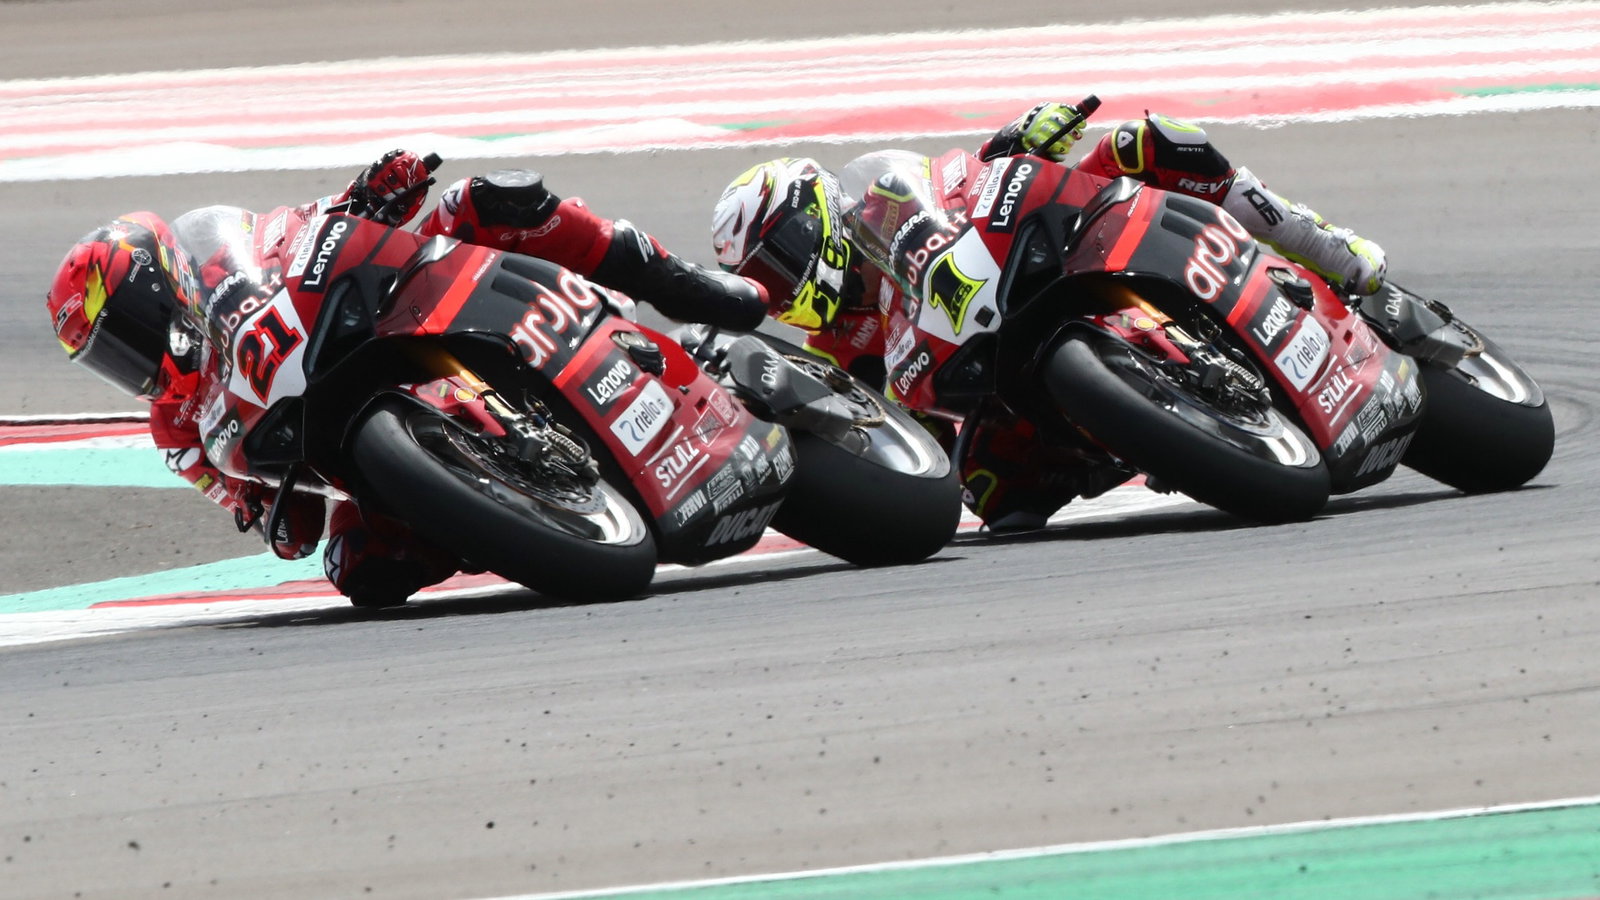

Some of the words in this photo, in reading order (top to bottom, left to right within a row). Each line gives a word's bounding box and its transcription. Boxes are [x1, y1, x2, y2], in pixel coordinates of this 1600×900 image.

[992, 164, 1032, 226] Lenovo
[304, 221, 347, 285] Lenovo
[905, 210, 968, 319] aruba.it
[508, 268, 599, 370] arua
[928, 252, 988, 336] 1
[1253, 296, 1292, 346] Lenovo
[220, 273, 282, 383] aruba.it
[237, 304, 304, 402] 21
[1299, 335, 1318, 369] riello
[587, 359, 632, 405] Lenovo
[895, 351, 930, 395] Lenovo
[634, 400, 660, 433] riello
[705, 497, 786, 547] DUCATI
